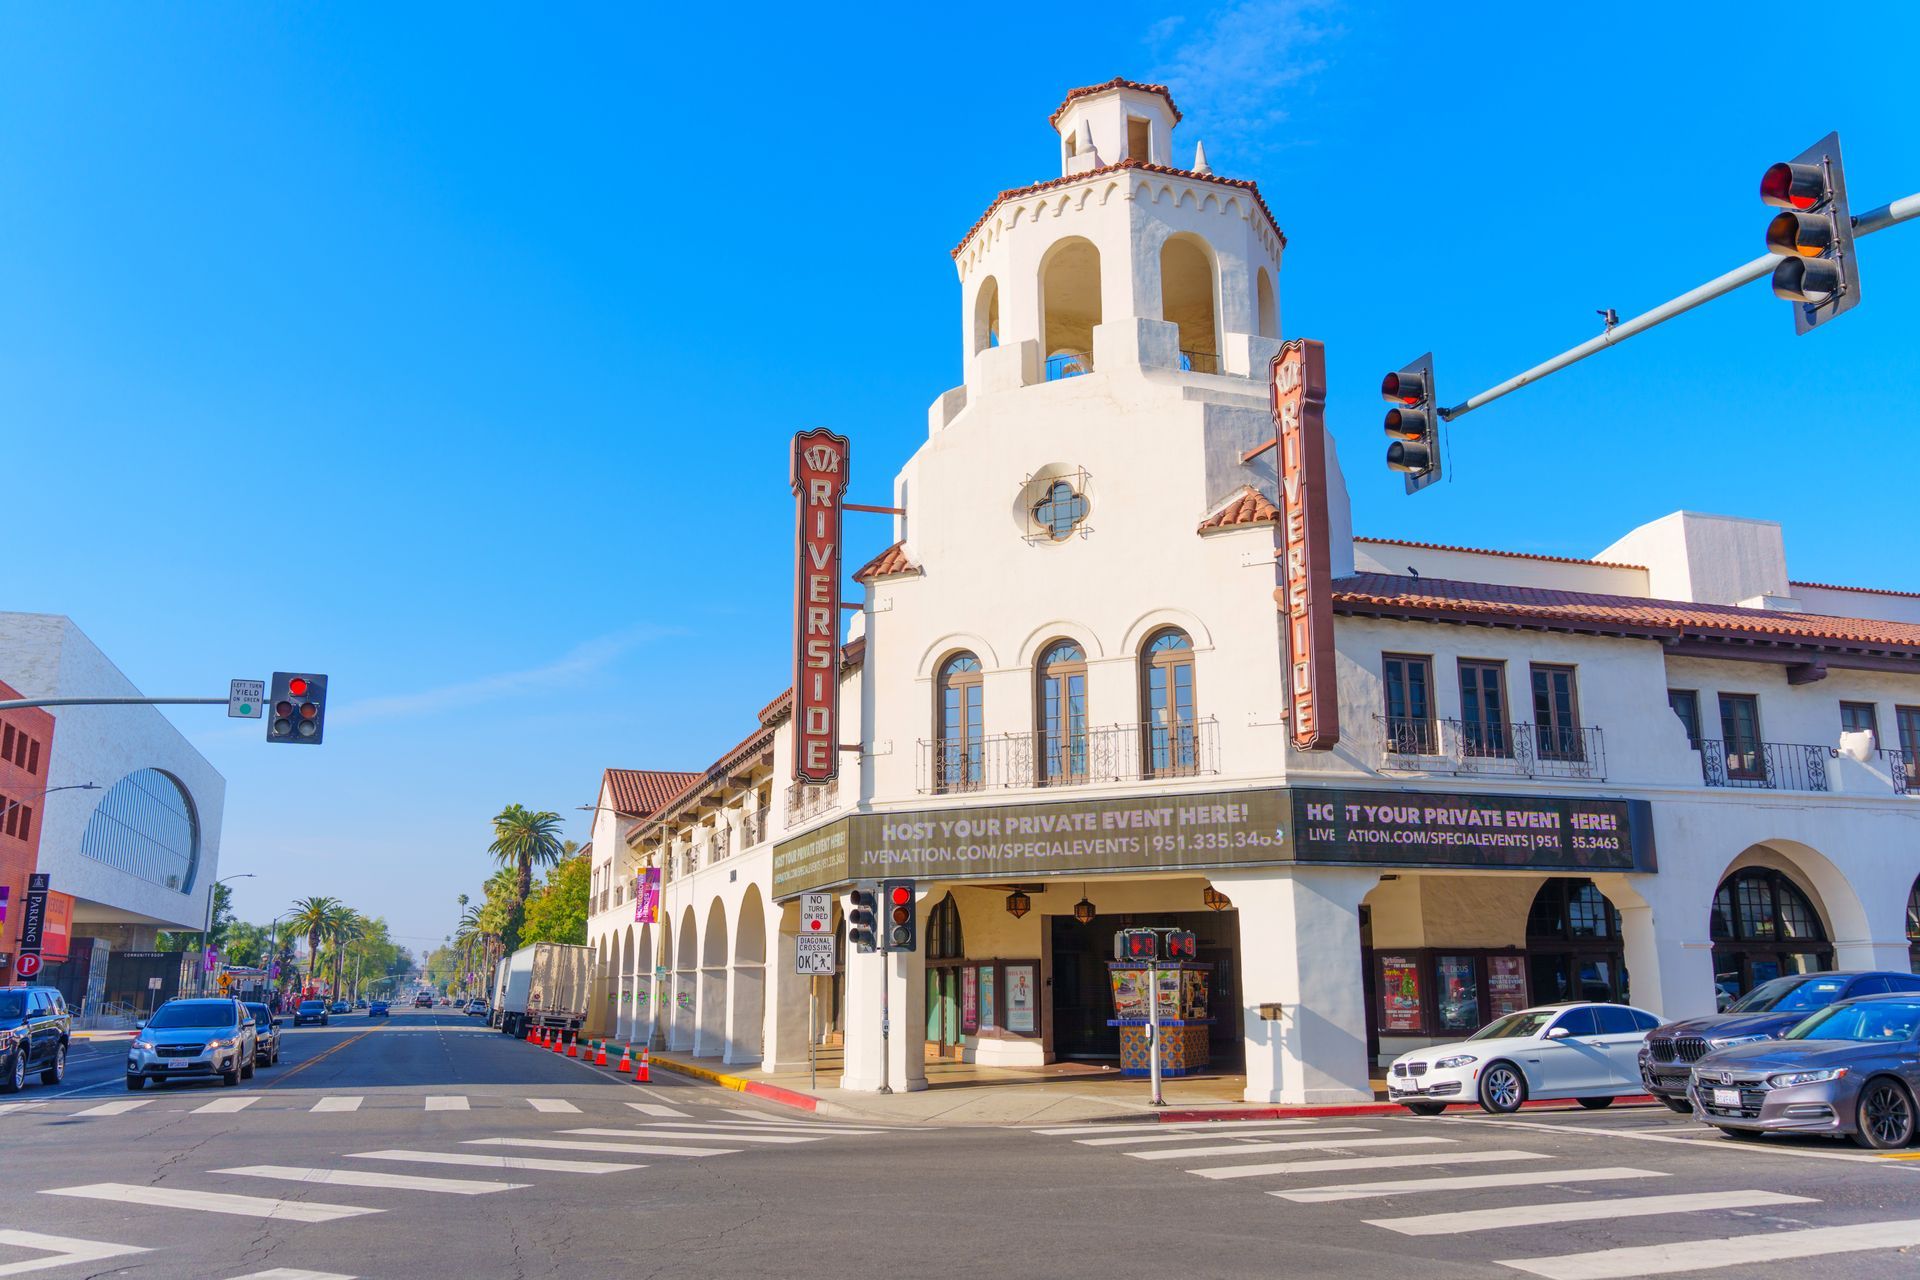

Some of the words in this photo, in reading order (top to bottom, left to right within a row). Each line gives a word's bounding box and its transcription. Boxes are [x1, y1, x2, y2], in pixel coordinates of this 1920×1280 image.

[1283, 401, 1312, 735] RIVERSIDE
[807, 478, 834, 770] RIVERSIDE
[882, 822, 936, 841] HOST
[940, 817, 1001, 839] YOUR
[1005, 812, 1097, 835] PRIVATE
[1101, 807, 1174, 830] EVENT
[1179, 803, 1249, 826] HERE!
[1307, 803, 1361, 822] HOT
[1363, 805, 1421, 824] YOUR
[1425, 807, 1503, 828] PRIVATE
[1505, 810, 1560, 829] EVENT
[860, 836, 1140, 865] IVENATION.COM/SPECIALEVENTS
[1309, 828, 1529, 847] LIVEATION.COM/SPECIALEVENTS
[1536, 835, 1619, 849] 951.35.3463
[810, 895, 823, 904] NO
[27, 896, 42, 942] PARKING
[800, 937, 830, 945] DIAGONAL
[22, 957, 36, 973] P
[798, 956, 811, 969] OK
